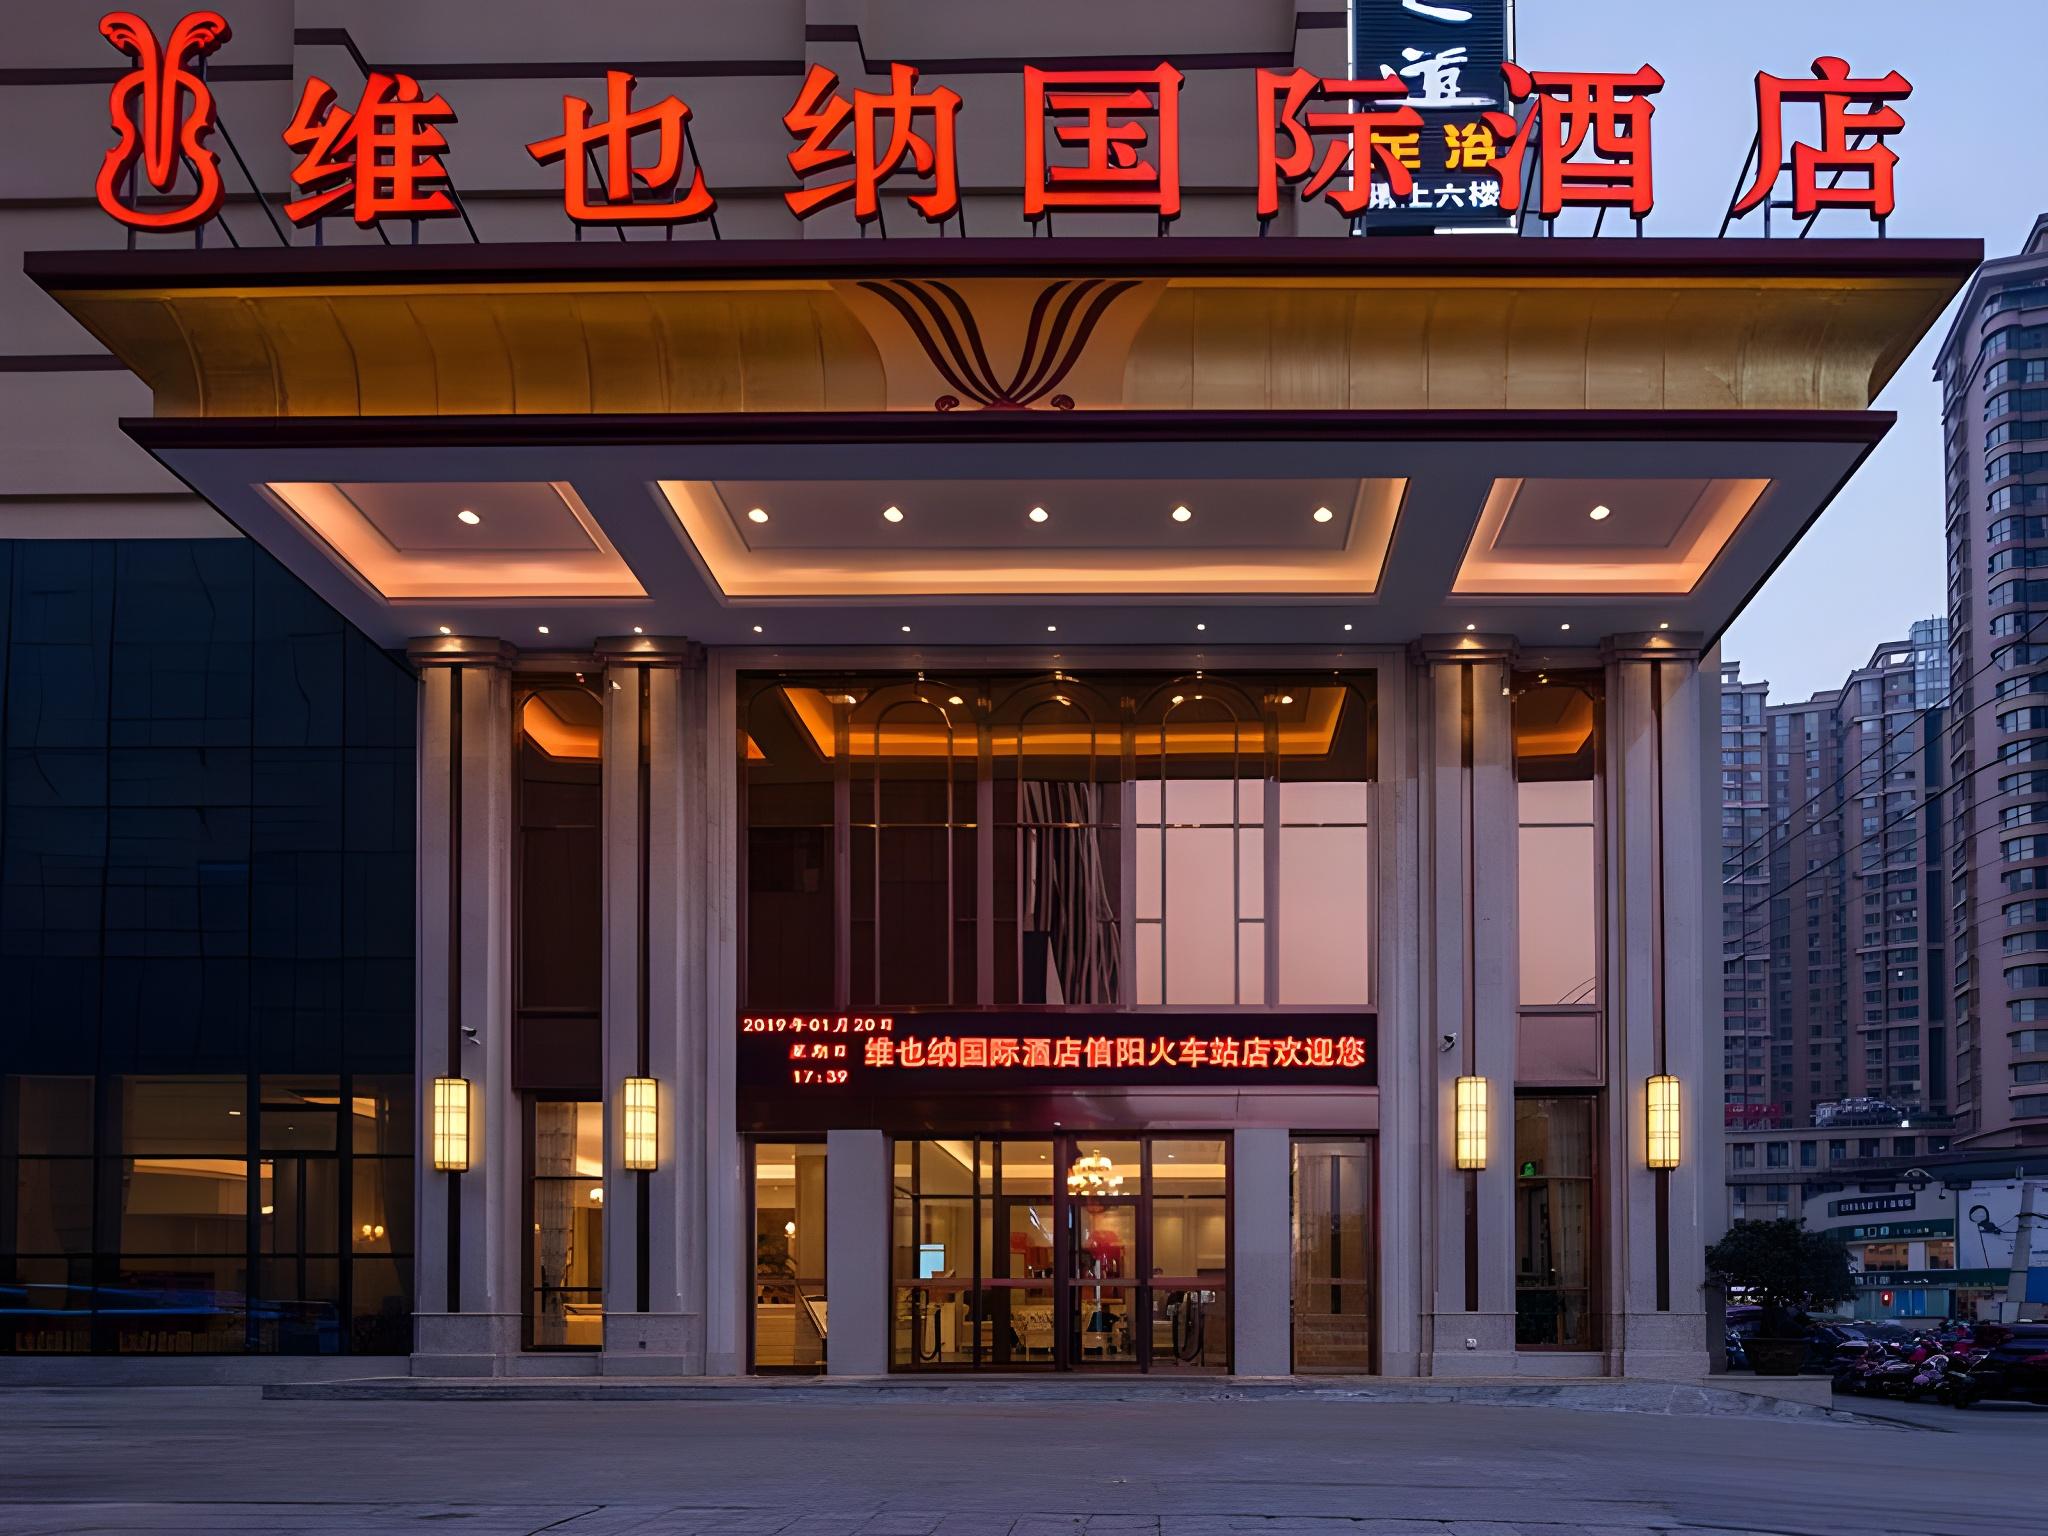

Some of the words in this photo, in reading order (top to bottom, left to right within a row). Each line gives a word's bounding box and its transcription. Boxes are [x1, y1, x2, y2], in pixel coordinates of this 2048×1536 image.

[283, 56, 1913, 230] 维也纳国际酒店
[864, 1035, 1367, 1068] 维也纳国际酒店信阳火车站店欢迎您
[793, 1069, 848, 1084] 17:39
